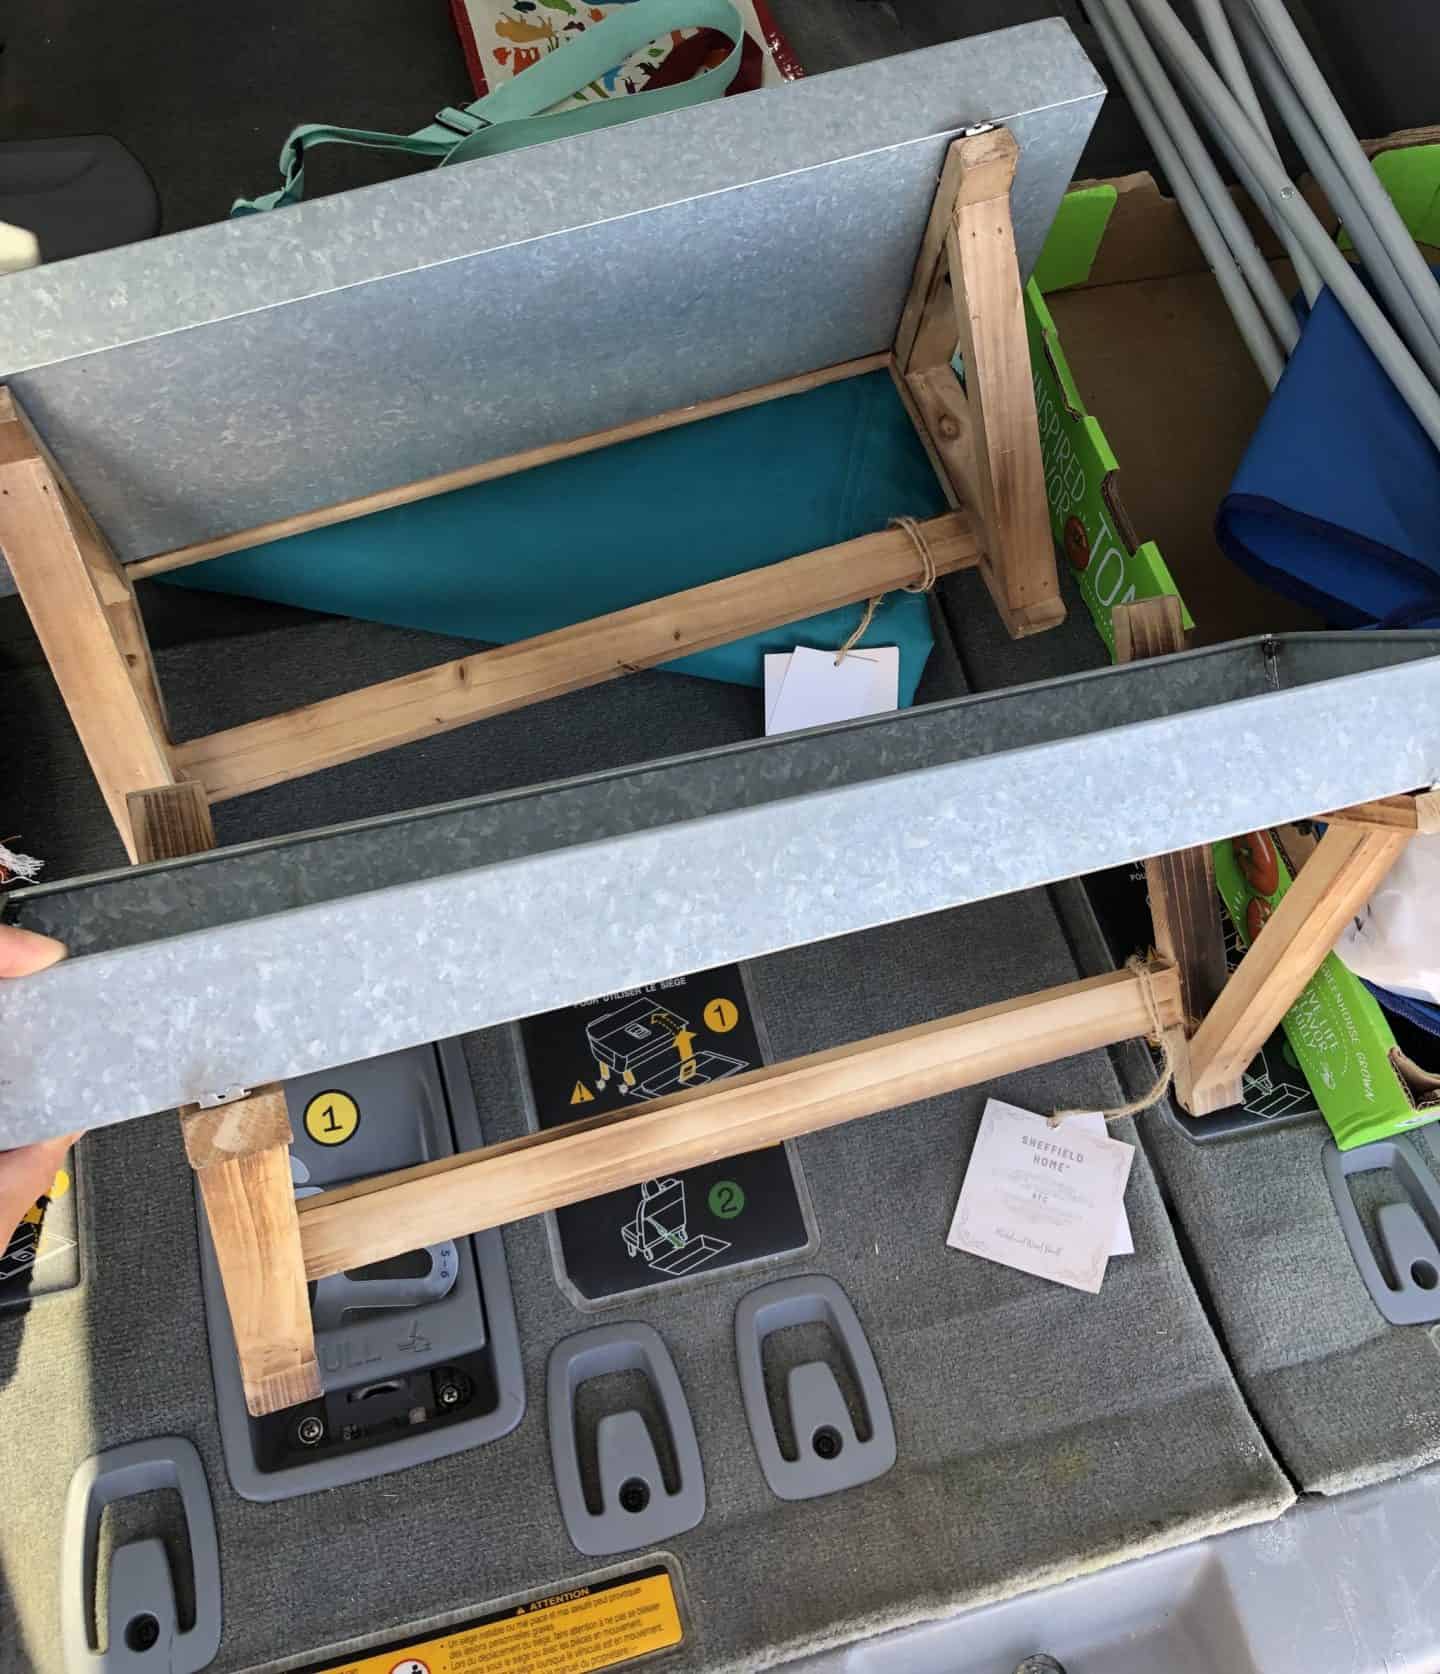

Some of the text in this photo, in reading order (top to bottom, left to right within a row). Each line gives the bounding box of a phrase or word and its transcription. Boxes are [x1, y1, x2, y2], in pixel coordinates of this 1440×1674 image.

[712, 1003, 727, 1027] 1
[1355, 1051, 1376, 1104] GROWN
[321, 1104, 343, 1133] 1
[1021, 1135, 1085, 1164] SHEFFIELD
[717, 1187, 738, 1213] 2
[529, 1586, 590, 1611] ATTENTION
